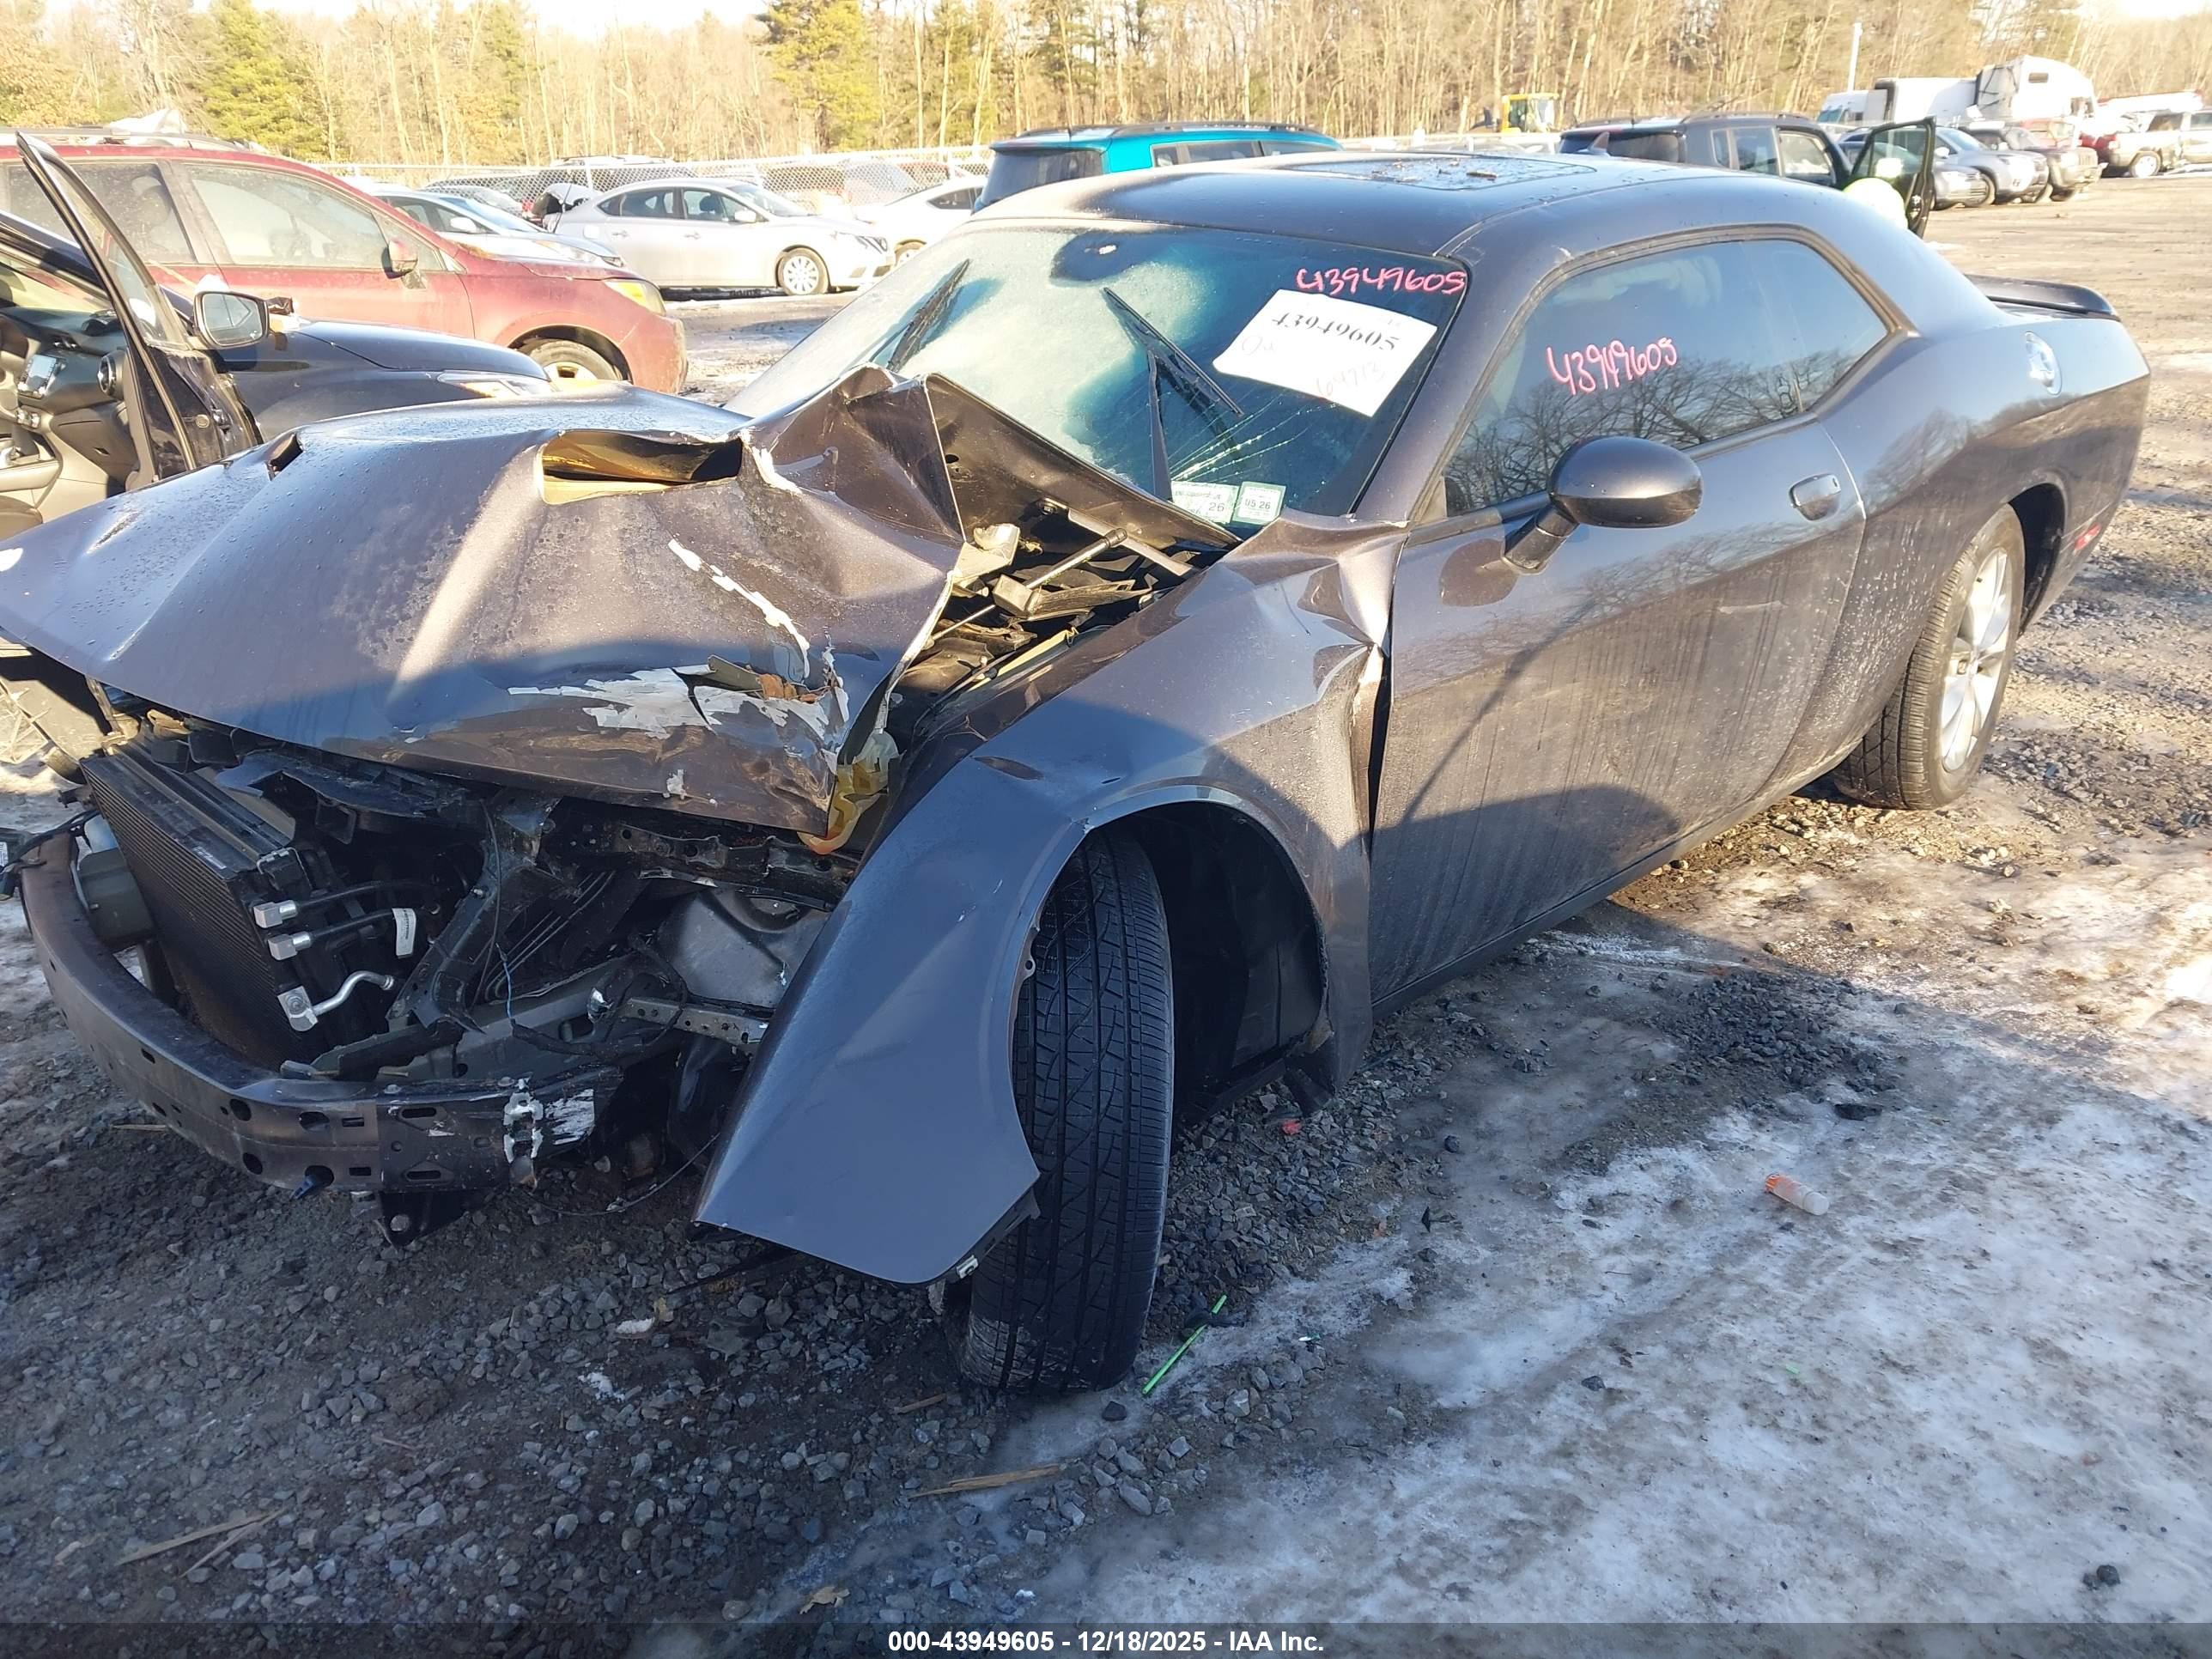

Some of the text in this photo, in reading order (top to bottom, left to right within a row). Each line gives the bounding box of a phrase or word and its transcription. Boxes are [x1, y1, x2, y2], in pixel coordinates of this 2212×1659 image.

[1296, 267, 1467, 296] 43949605
[1271, 311, 1401, 351] 43949605
[1546, 337, 1678, 396] 43949605
[1208, 501, 1225, 513] 26
[1258, 501, 1271, 510] 26
